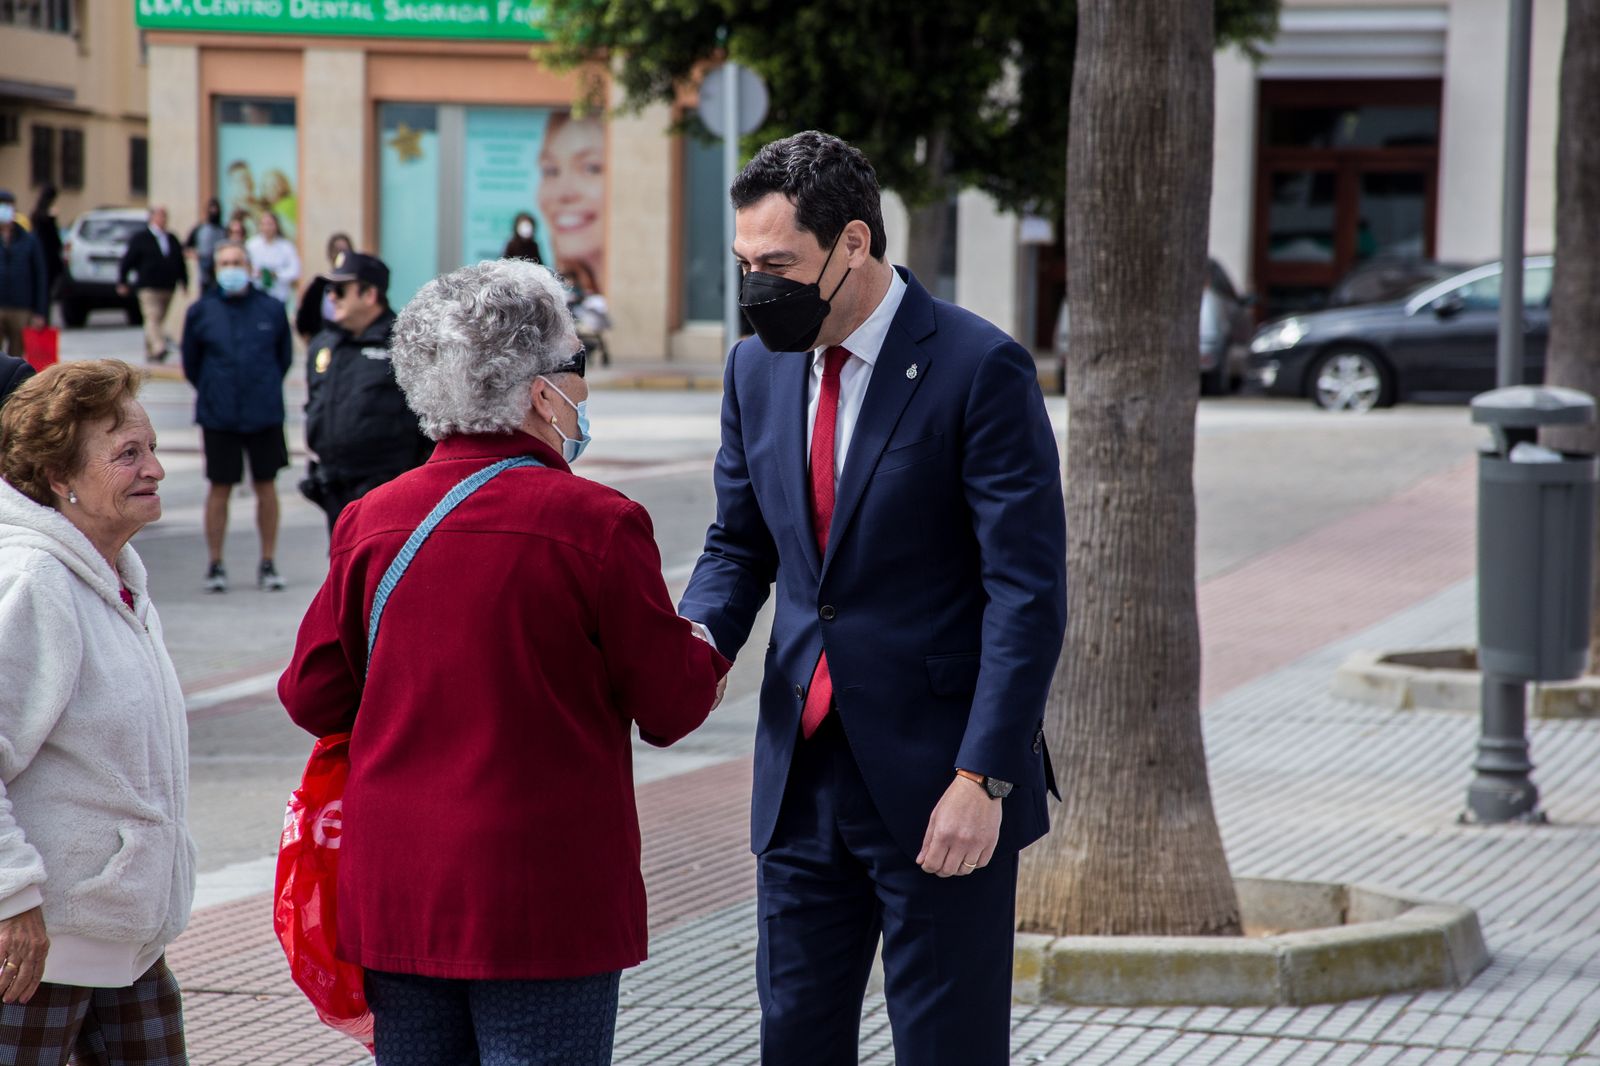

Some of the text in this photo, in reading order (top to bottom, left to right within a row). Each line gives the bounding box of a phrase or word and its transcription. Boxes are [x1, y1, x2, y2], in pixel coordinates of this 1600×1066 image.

[193, 0, 283, 17] CENTRO
[289, 0, 374, 20] DENTAL
[383, 0, 490, 23] SAGRADA
